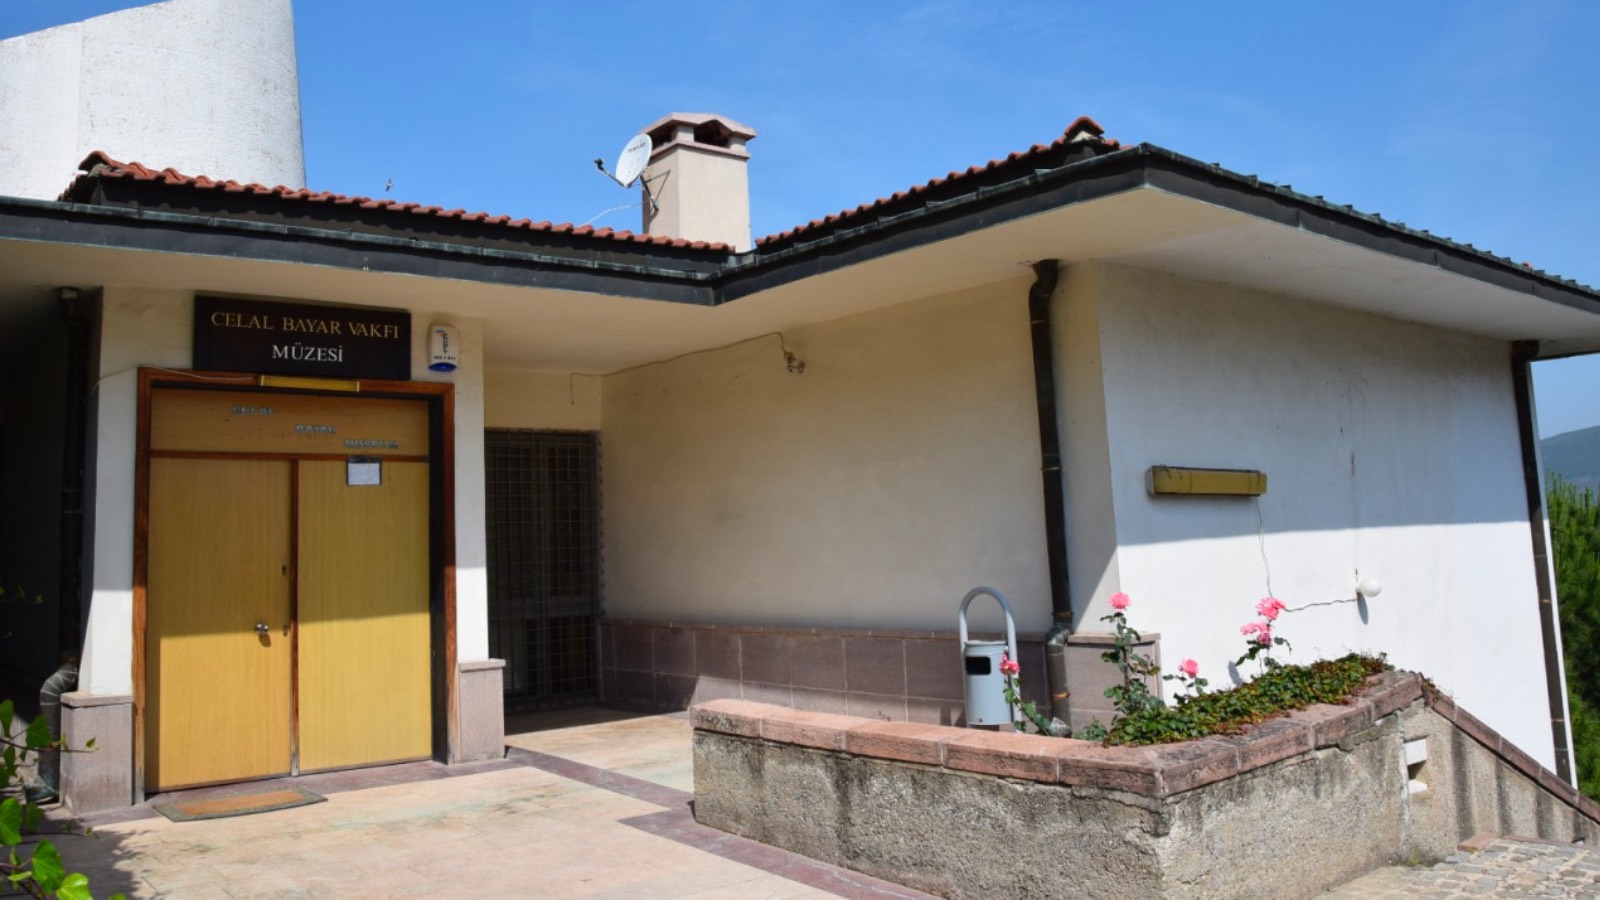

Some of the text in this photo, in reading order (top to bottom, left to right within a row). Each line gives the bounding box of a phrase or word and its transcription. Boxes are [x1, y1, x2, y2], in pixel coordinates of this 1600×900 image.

[211, 311, 400, 339] CELAL BAYAR VAKFI
[271, 342, 343, 362] MÜZESİ
